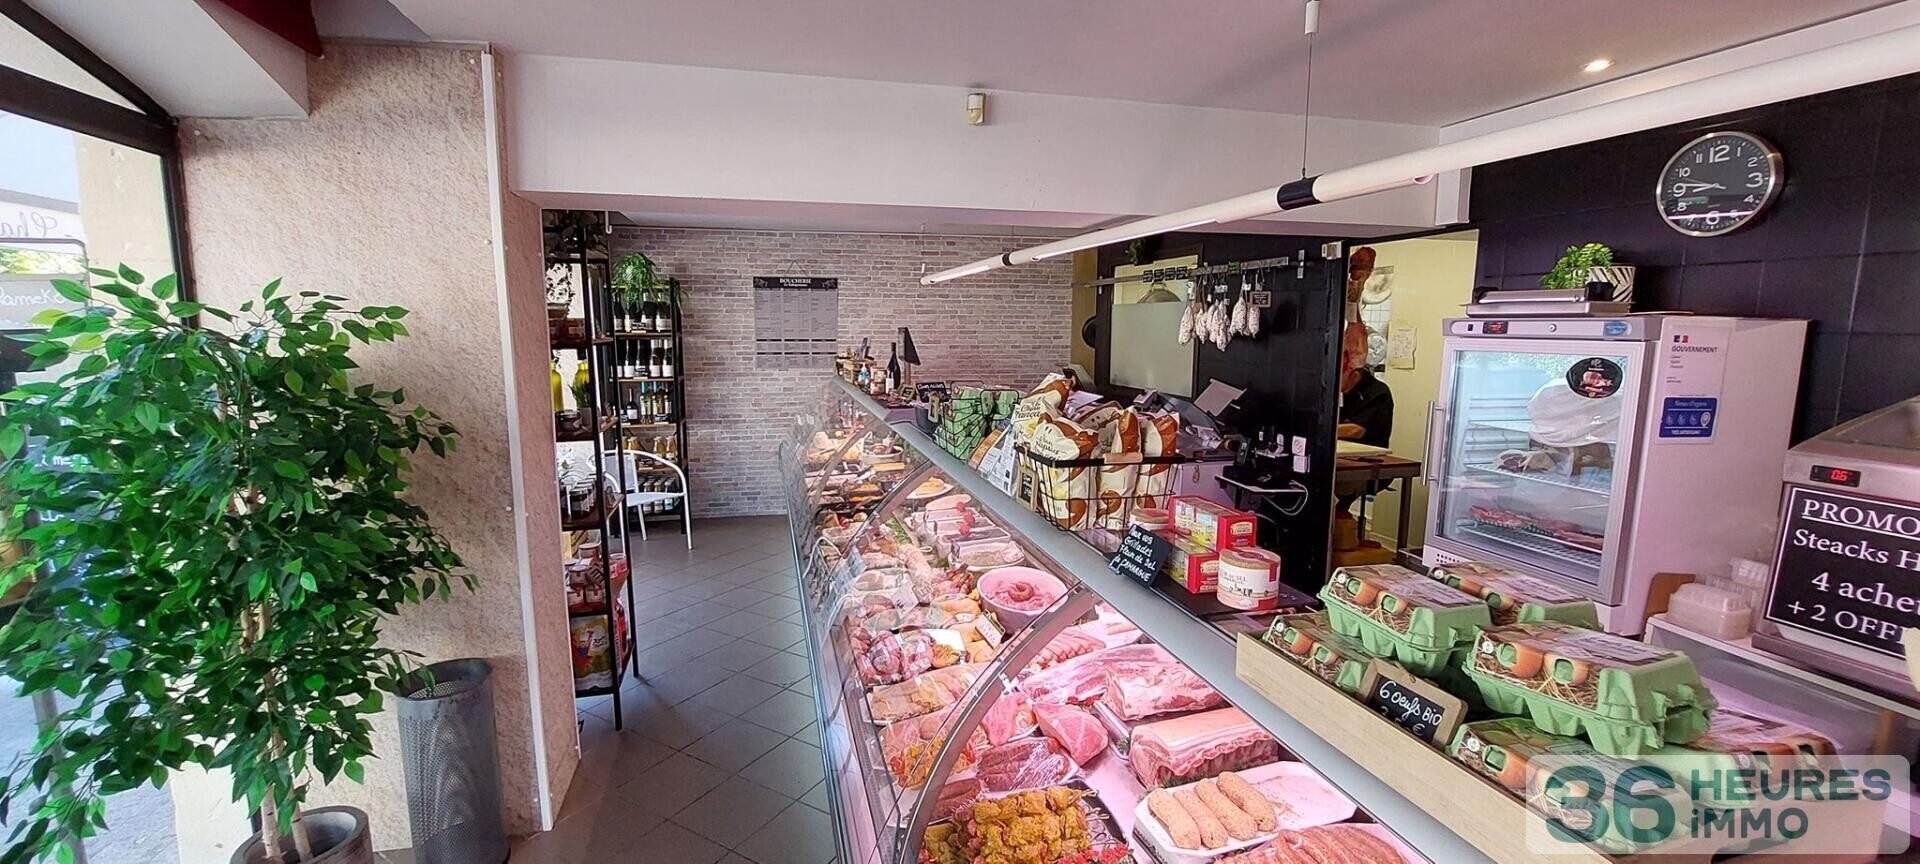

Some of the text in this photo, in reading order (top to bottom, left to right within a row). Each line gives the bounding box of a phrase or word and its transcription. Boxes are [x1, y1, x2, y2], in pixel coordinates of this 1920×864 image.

[1695, 153, 1703, 163] 11
[1709, 144, 1731, 163] 12
[1736, 146, 1742, 157] 1
[1747, 156, 1758, 168] 2
[1678, 167, 1691, 178] 10
[1745, 171, 1763, 188] 3
[1673, 182, 1686, 197] 9
[1743, 194, 1754, 203] 4
[1676, 201, 1688, 212] 8
[1705, 210, 1720, 225] 6
[1671, 345, 1718, 353] GOUVERNEMENT
[1802, 499, 1920, 536] PROMO
[1124, 535, 1153, 557] Grillades
[1793, 528, 1920, 572] Steacks H
[1811, 571, 1831, 592] 4
[1787, 600, 1806, 615] +
[1810, 603, 1827, 623] 2
[1379, 680, 1397, 699] 6
